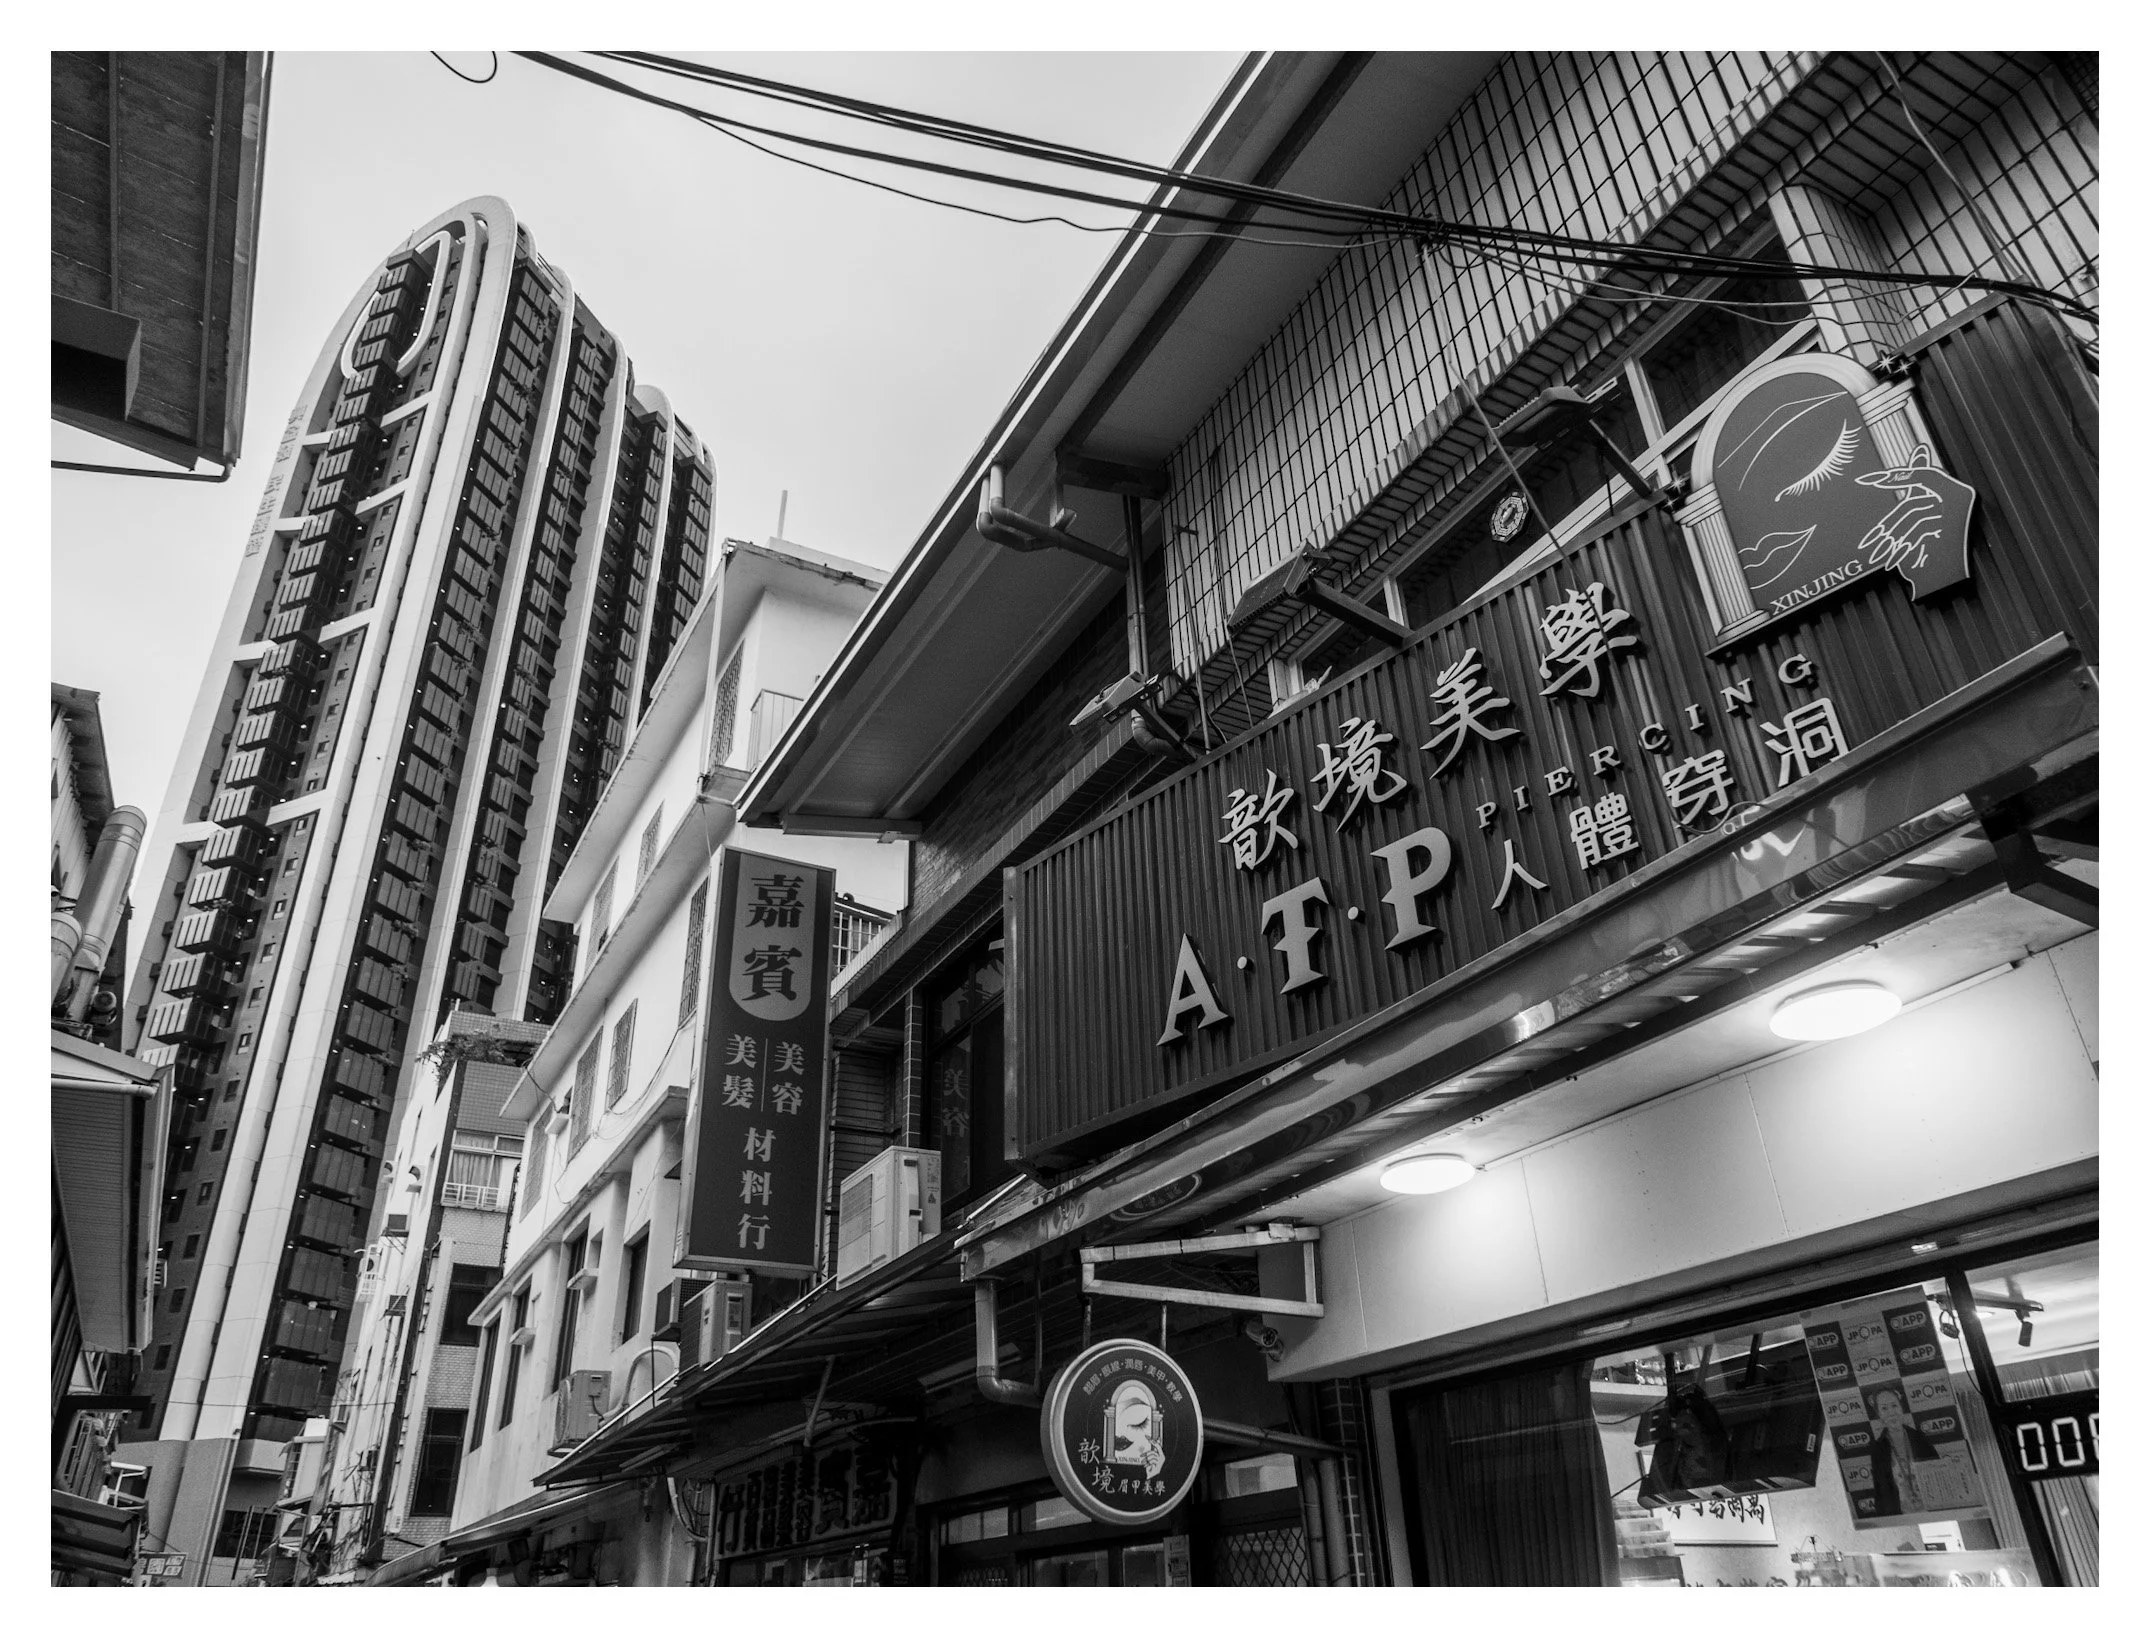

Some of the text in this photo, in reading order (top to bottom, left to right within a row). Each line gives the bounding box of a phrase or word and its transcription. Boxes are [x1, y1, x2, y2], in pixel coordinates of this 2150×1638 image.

[1771, 558, 1864, 616] XINJING
[1219, 582, 1637, 872] 歆境美學
[1478, 655, 1815, 830] PIERCING
[1490, 697, 1848, 911] 人體穿洞
[741, 874, 805, 1001] 嘉賓
[722, 1034, 756, 1109] 美髮
[772, 1041, 805, 1116] 美容
[737, 1127, 776, 1250] 材料行
[1078, 1438, 1115, 1494] 歆境
